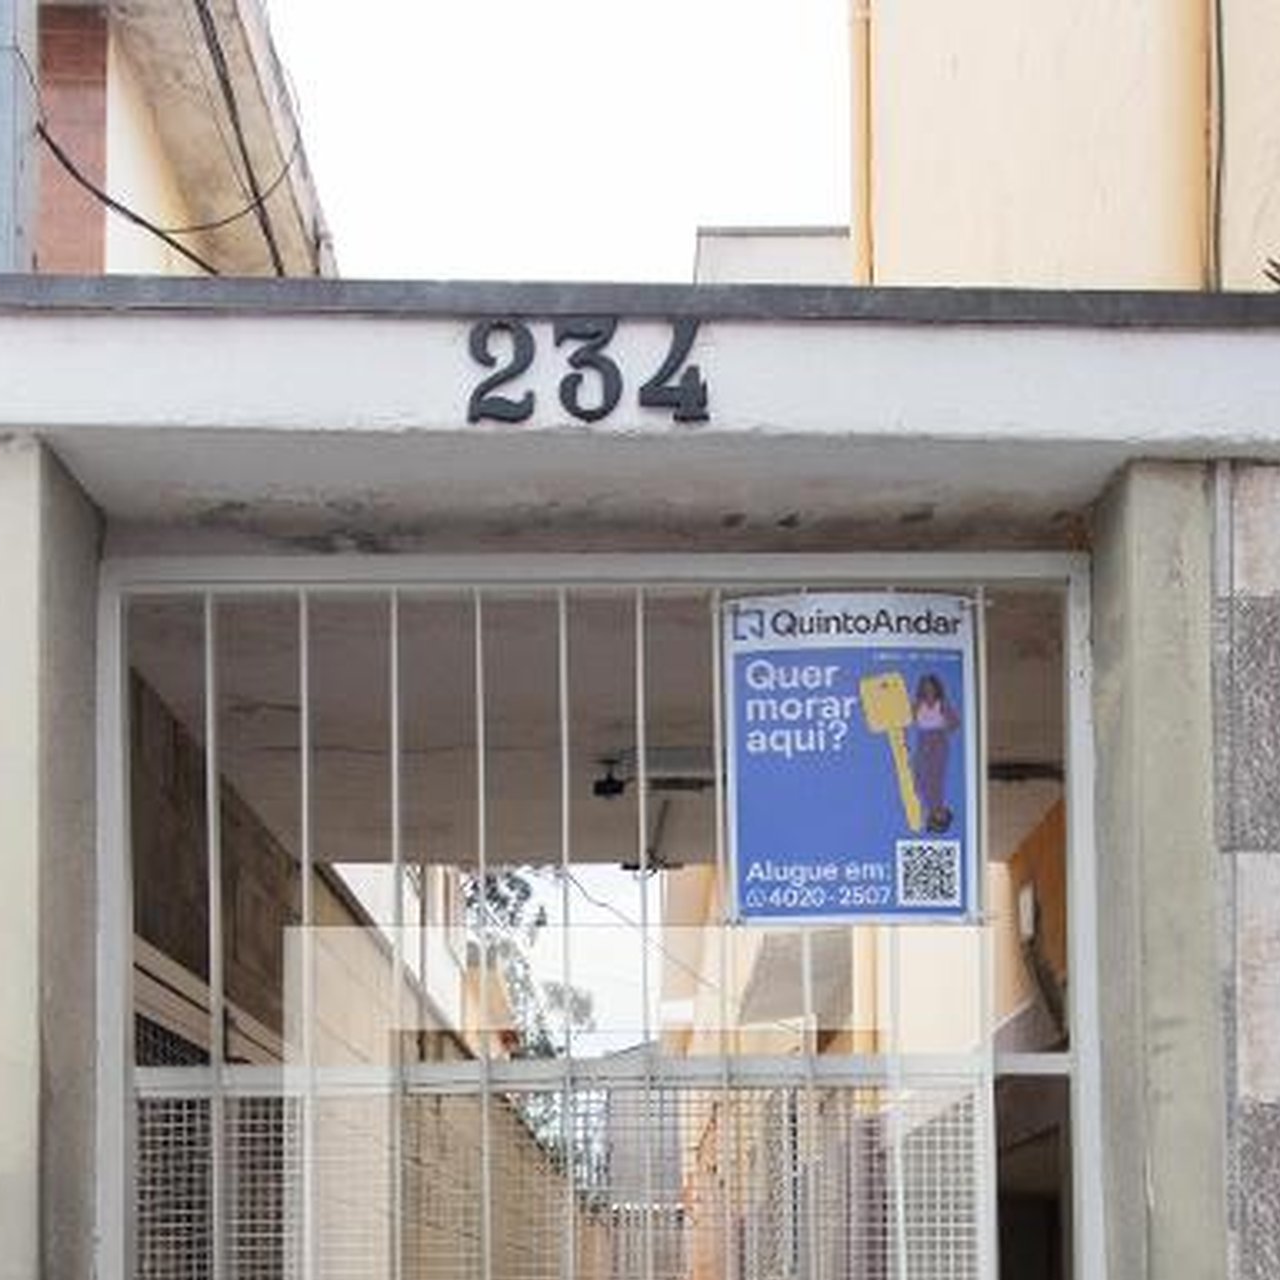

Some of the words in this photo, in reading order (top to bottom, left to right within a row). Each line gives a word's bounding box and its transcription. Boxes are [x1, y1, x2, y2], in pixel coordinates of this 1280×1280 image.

[467, 315, 710, 423] 234
[771, 608, 961, 637] QuintoAndar
[746, 659, 840, 691] Quer
[746, 697, 857, 720] morar
[746, 720, 848, 759] aqui?
[746, 860, 838, 887] Alugue
